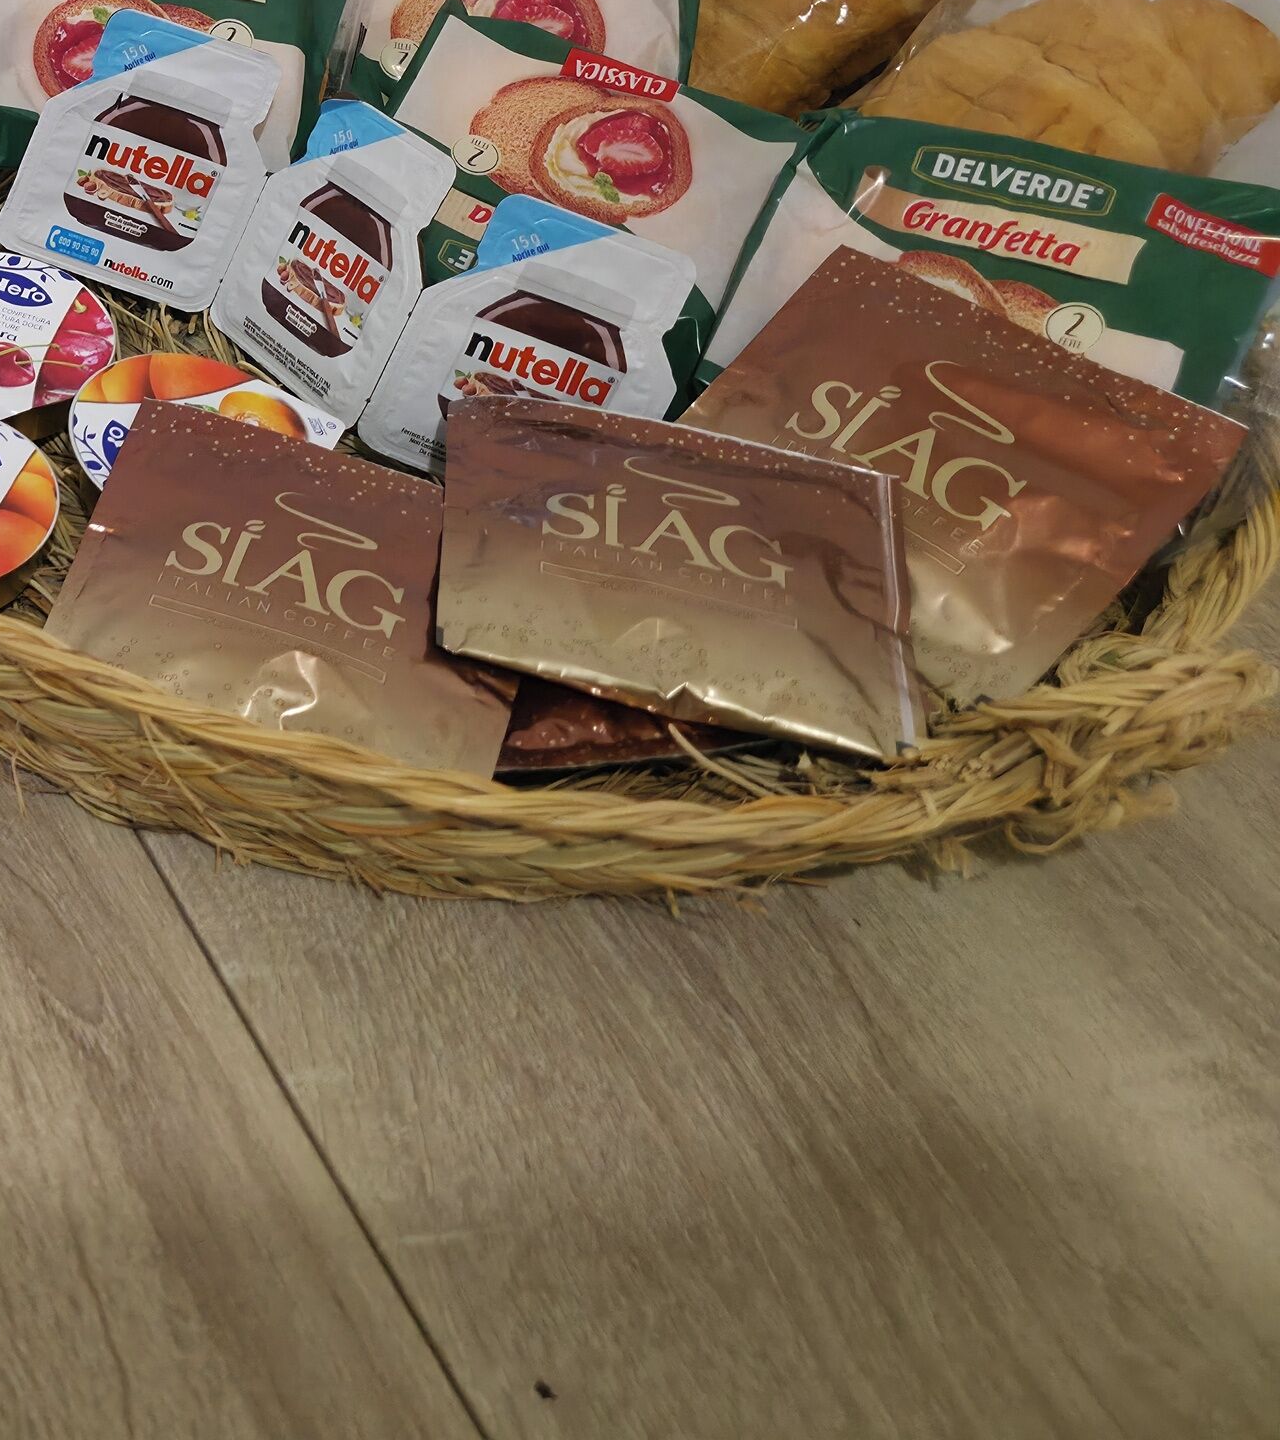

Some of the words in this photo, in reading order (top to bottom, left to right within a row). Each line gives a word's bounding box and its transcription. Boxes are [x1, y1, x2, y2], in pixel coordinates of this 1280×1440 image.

[122, 46, 137, 60] 15
[575, 59, 666, 95] CLASSICA
[85, 134, 216, 198] nutella
[932, 153, 1091, 208] DELVERDE
[903, 201, 1081, 266] Granfetta
[1163, 204, 1263, 252] CONFEZIONE
[102, 257, 175, 290] nutella.com
[288, 220, 381, 305] nutella
[1, 305, 52, 326] CONFETTURA
[21, 319, 43, 331] DOCE
[1064, 313, 1085, 338] 2
[464, 331, 612, 406] nutella
[540, 540, 665, 574] ITALIAN
[158, 567, 270, 616] ITALIAN
[283, 608, 397, 657] COFFEE
